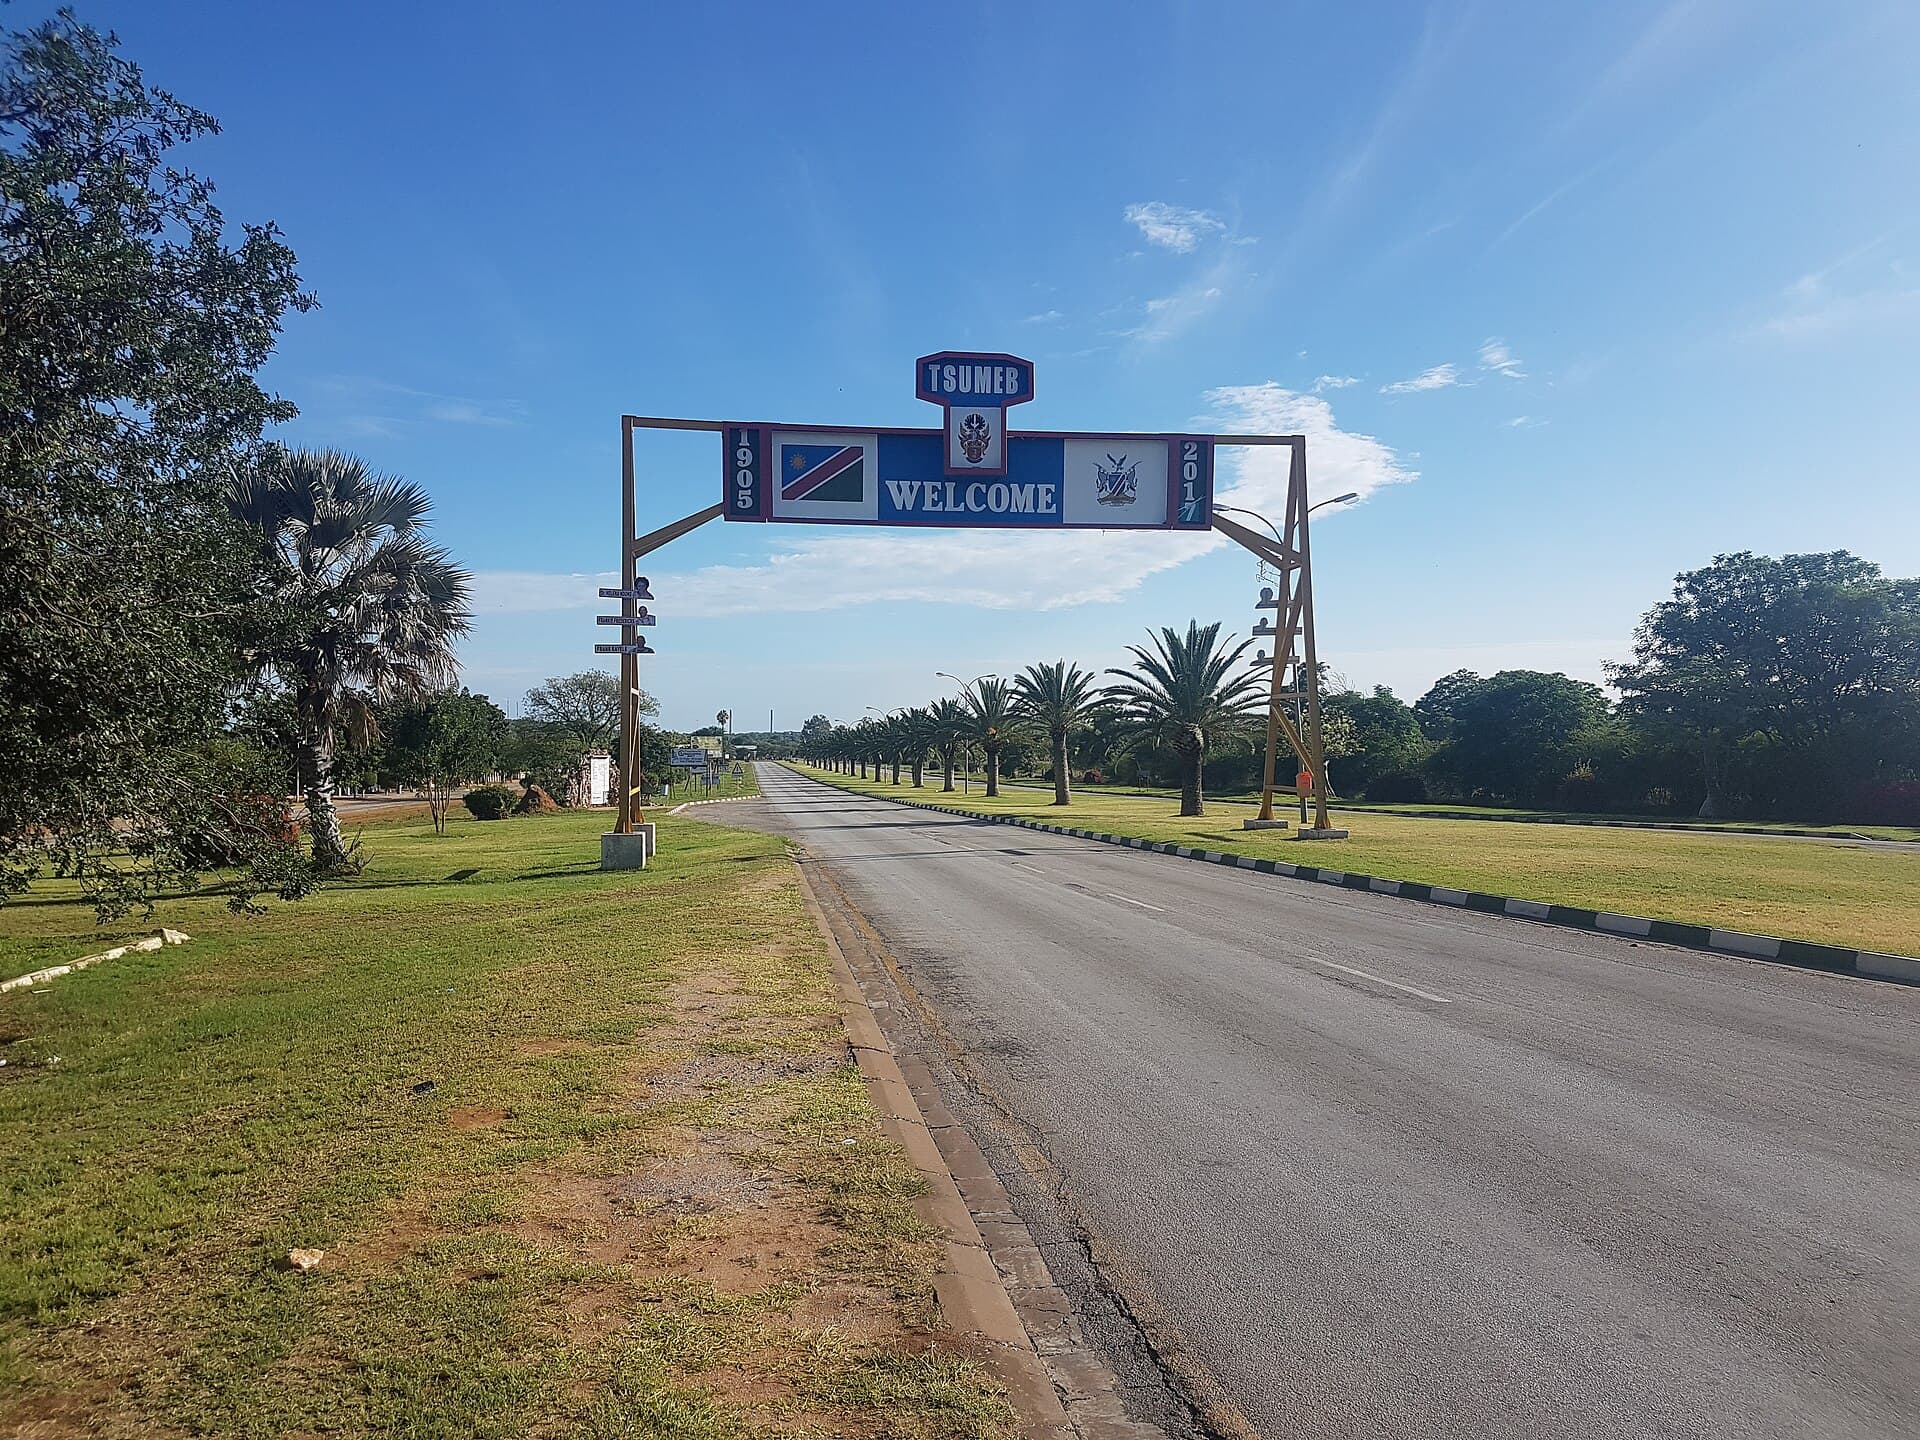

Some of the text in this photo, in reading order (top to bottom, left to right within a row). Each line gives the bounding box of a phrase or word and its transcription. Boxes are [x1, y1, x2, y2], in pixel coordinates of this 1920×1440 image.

[928, 364, 1019, 394] TSUMEB
[736, 429, 753, 509] 1905
[885, 480, 1057, 513] WELCOME
[1183, 441, 1198, 521] 2017
